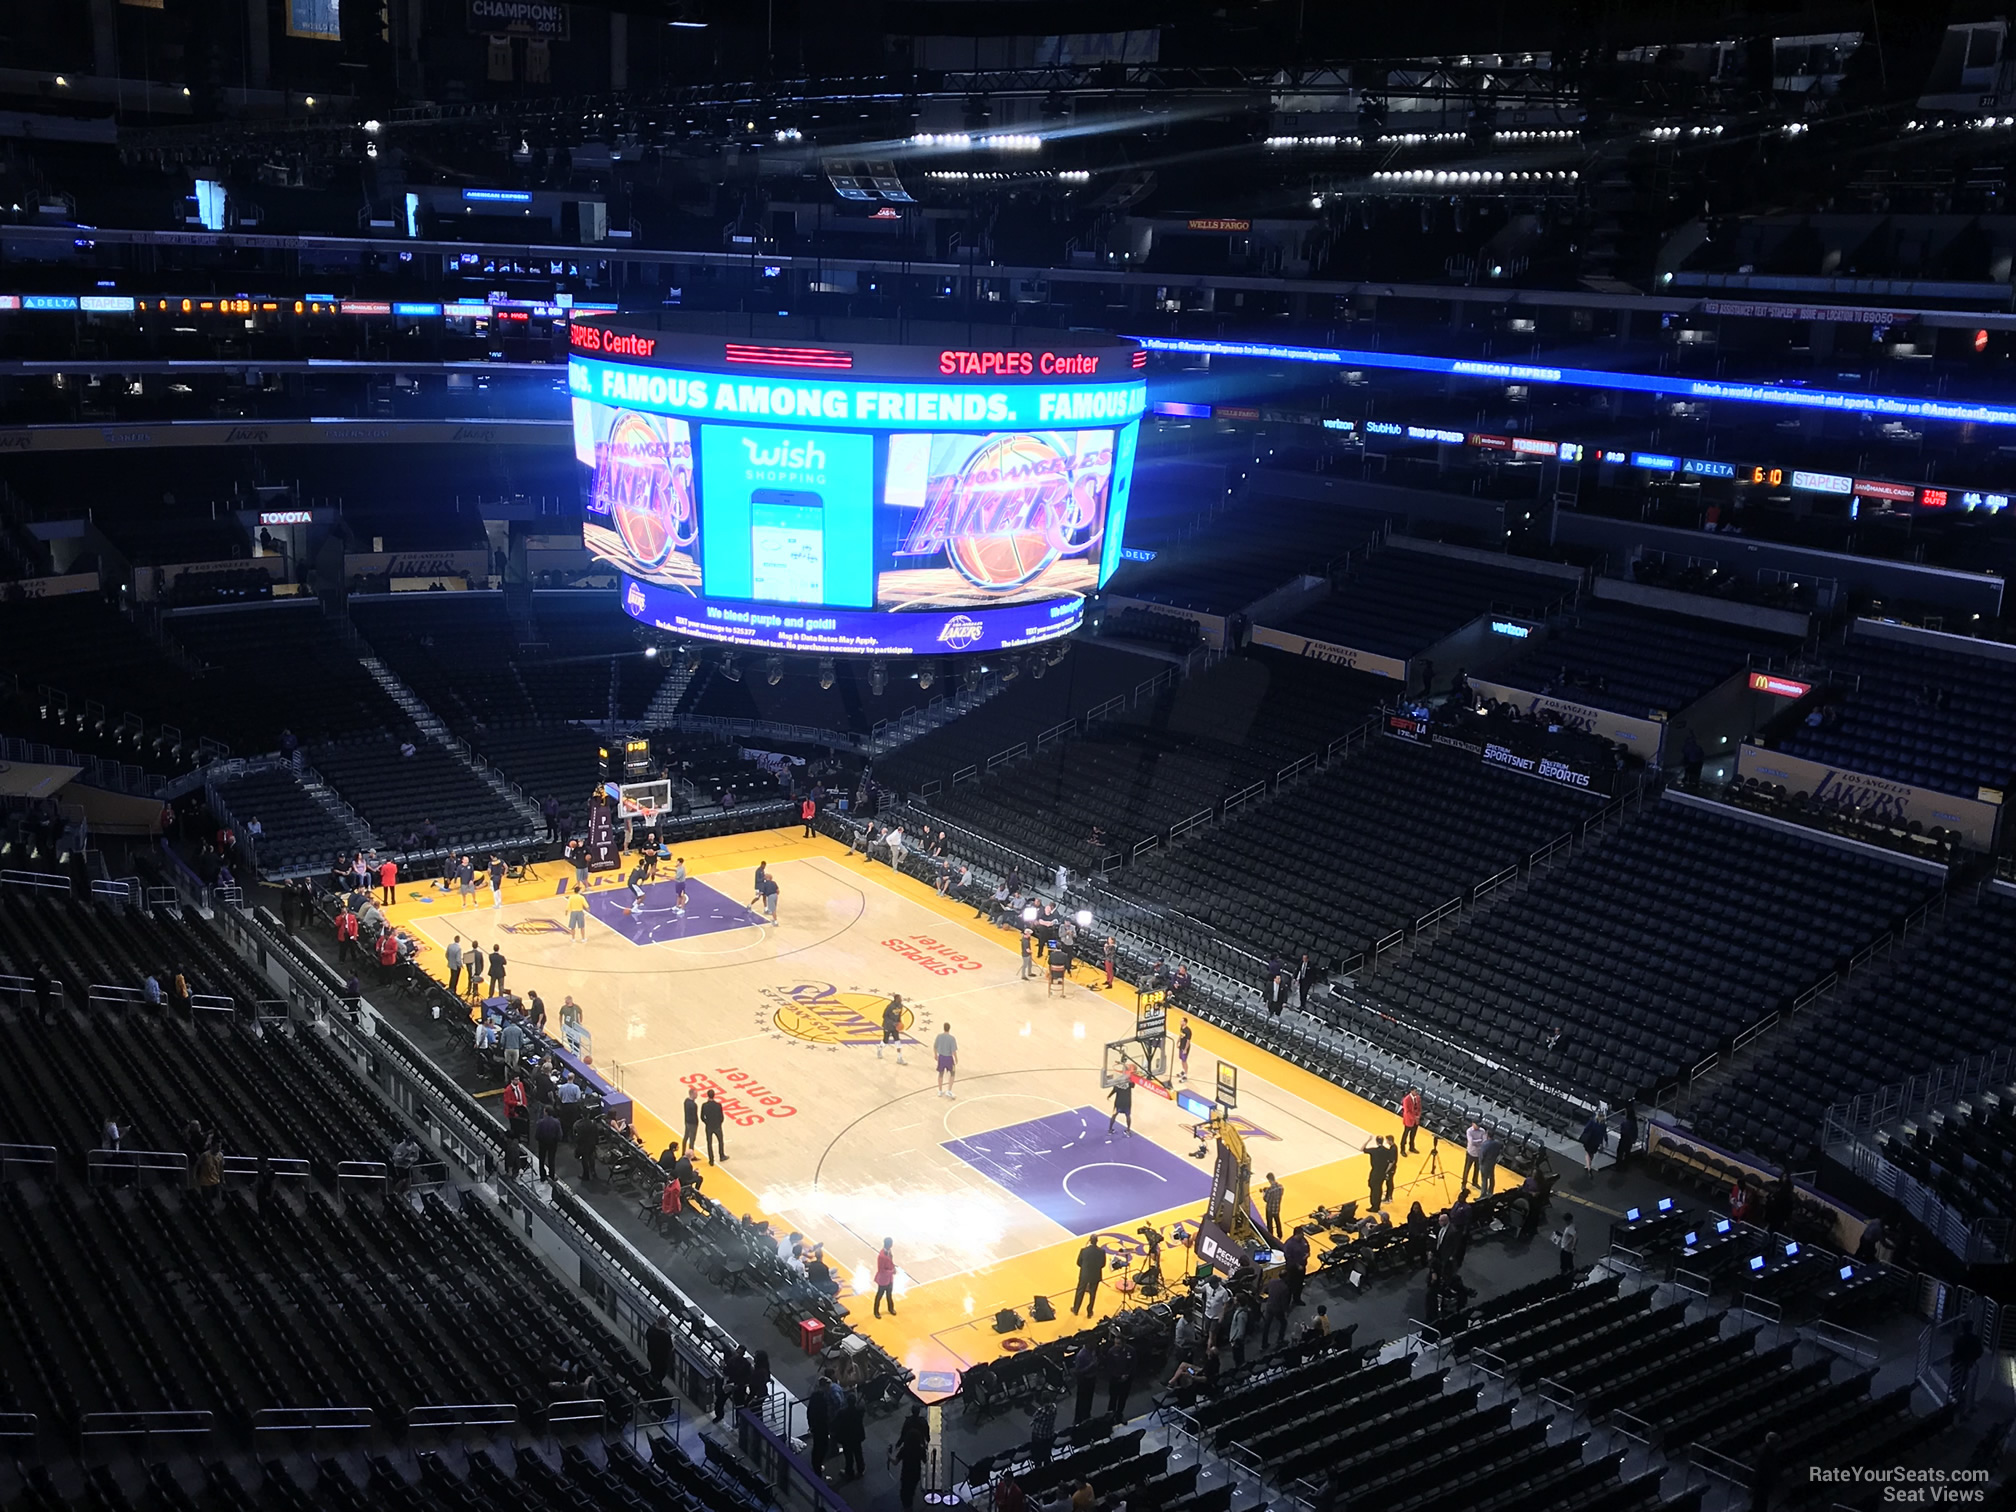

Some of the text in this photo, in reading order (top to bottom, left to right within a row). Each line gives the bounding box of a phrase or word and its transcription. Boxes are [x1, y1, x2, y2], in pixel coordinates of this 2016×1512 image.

[466, 191, 500, 199] AMERICAN
[1189, 220, 1249, 230] WELLS FARGO
[37, 298, 77, 308] DELTA
[82, 298, 132, 309] STAPLES
[446, 305, 492, 315] TOSHIBA
[1705, 303, 1718, 314] NEED
[1719, 304, 1754, 316] ASSISTANCE?
[1755, 306, 1767, 317] TEXT
[1827, 311, 1854, 322] LOCATION
[1863, 312, 1894, 324] 69050
[603, 329, 656, 357] Center
[940, 350, 1099, 375] STAPLES Center
[1453, 361, 1561, 381] AMERICAN EXPRESS
[602, 368, 709, 409] FAMOUS
[714, 382, 849, 419] AMONG
[856, 391, 1017, 421] FRIENDS.
[1039, 389, 1128, 421] FAMOUS
[1693, 382, 1721, 394] Unlock
[1728, 387, 1752, 398] world
[1753, 388, 1763, 399] of
[1763, 390, 1824, 404] entertainment
[1825, 395, 1843, 406] and
[1844, 397, 1875, 410] sports.
[1877, 398, 1907, 412] Follow
[1908, 404, 1920, 413] us
[1323, 418, 1354, 430] verizon
[1366, 421, 1402, 435] StubHub
[631, 440, 692, 458] ANGELES
[742, 437, 826, 470] wish
[1513, 438, 1557, 455] TOSHIBA
[1002, 448, 1113, 479] ANGELES
[1696, 462, 1734, 476] DELTA
[745, 469, 827, 485] SHOPPING
[1754, 466, 1782, 485] 6:10
[1795, 472, 1849, 491] STAPLES
[1855, 483, 1914, 498] SAN MANUEL CASINO
[1924, 489, 1948, 498] TIME
[1924, 497, 1946, 506] OUTS
[260, 511, 312, 524] TOYOTA
[892, 472, 1110, 554] LAKERS
[675, 616, 688, 625] TEXT
[700, 623, 725, 633] message
[733, 627, 756, 637] 525377
[707, 606, 836, 631] We bleed purple and gold!!
[778, 631, 793, 641] Msg
[801, 633, 817, 642] Data
[818, 635, 838, 643] Rates
[839, 635, 854, 645] May
[855, 637, 879, 646] Apply.
[937, 623, 984, 641] LAKERS
[1492, 621, 1529, 639] verizon
[797, 643, 829, 651] purchase
[830, 645, 865, 654] necessary
[875, 646, 913, 655] participate
[1545, 700, 1598, 718] LOS ANGELES
[1416, 723, 1426, 735] LA
[1486, 743, 1511, 754] SPECTRUM
[1484, 749, 1535, 770] SPORTSNET
[1541, 758, 1569, 770] SPECTRUM
[1538, 764, 1590, 786] DEPORTES
[1842, 773, 1911, 796] LOS ANGELES
[1810, 770, 1910, 818] LAKERS
[881, 937, 958, 976] STAPLES
[909, 934, 983, 971] Center
[777, 979, 928, 1048] LAKERS
[809, 1015, 838, 1036] LOS
[716, 1067, 797, 1118] Center
[1144, 1081, 1169, 1098] AAA.com
[680, 1073, 765, 1127] STAPLES
[1216, 1247, 1241, 1267] PECHA
